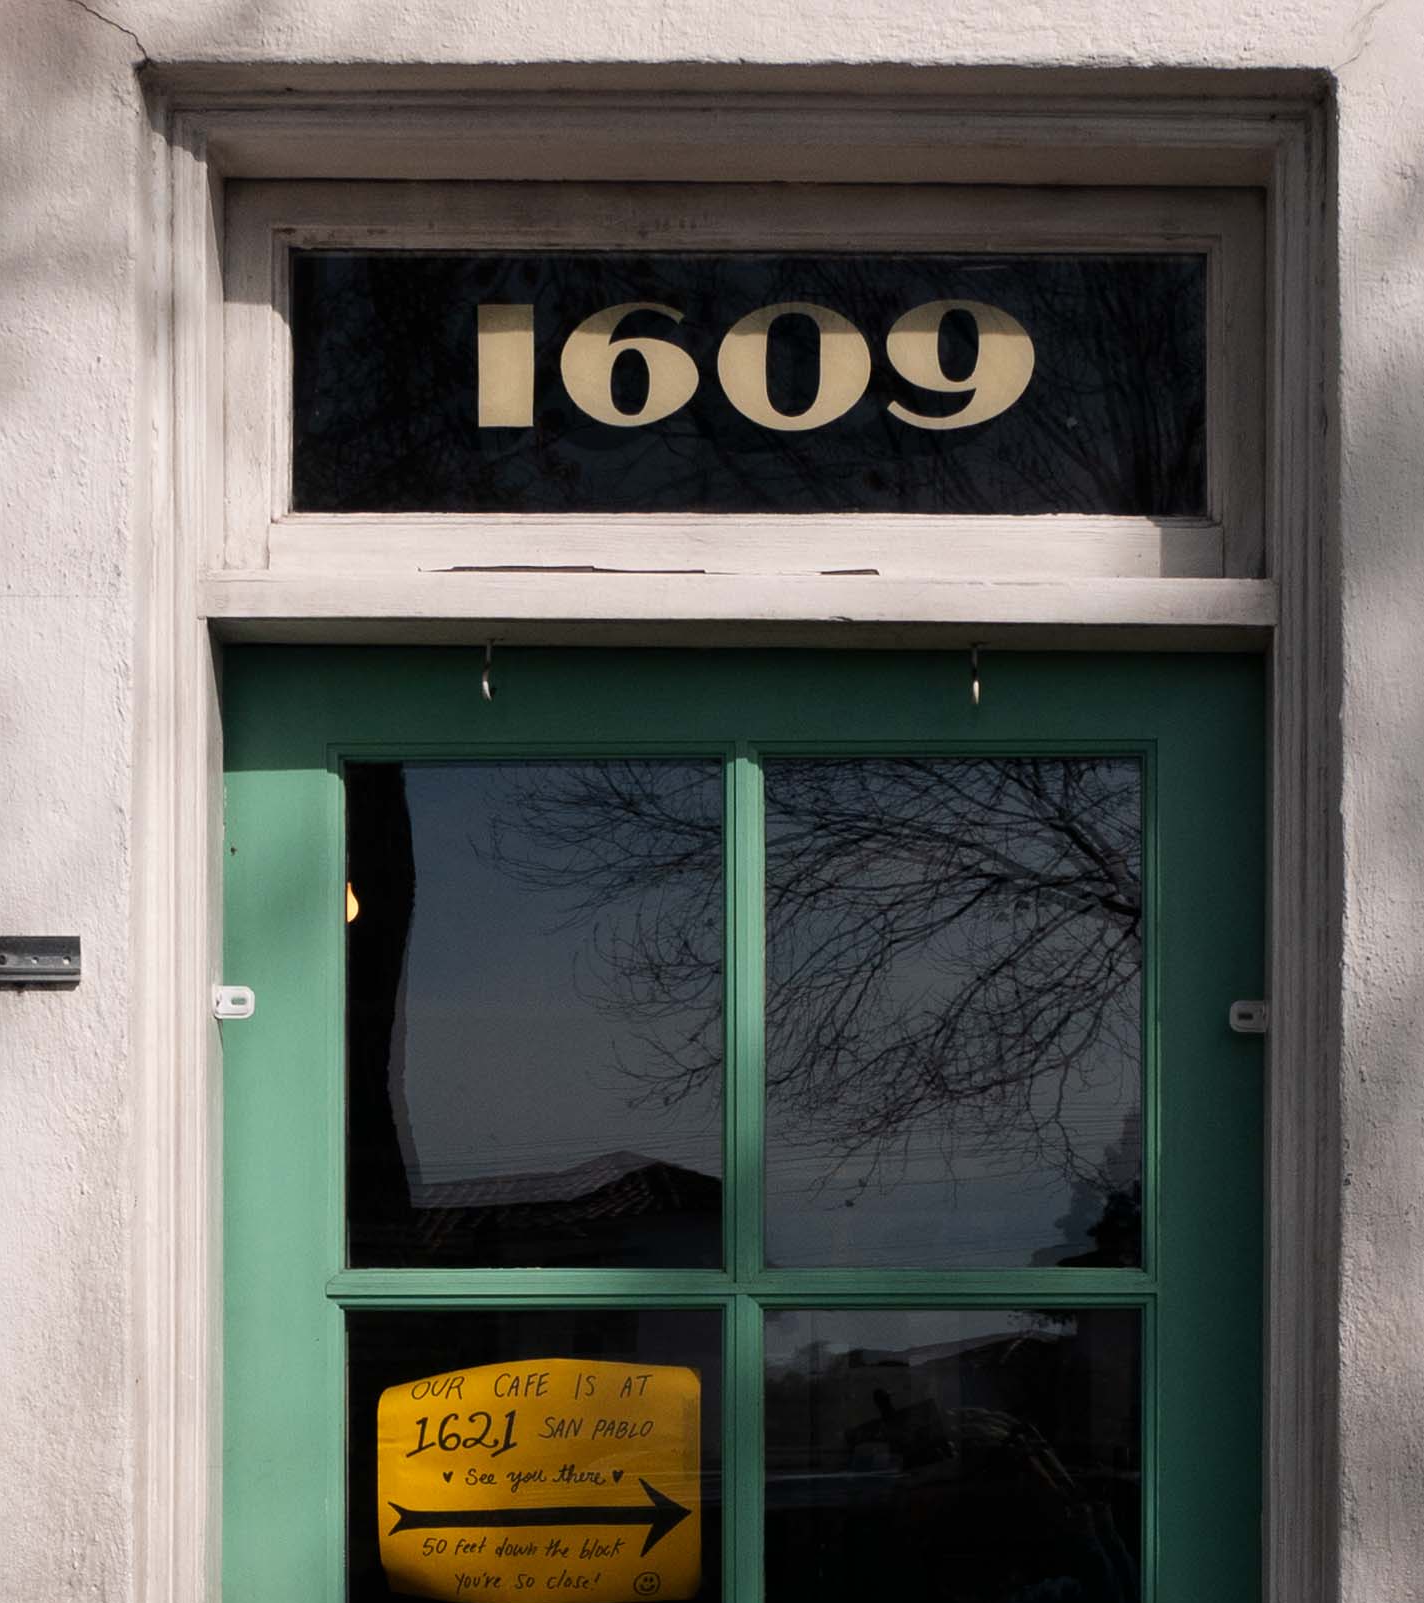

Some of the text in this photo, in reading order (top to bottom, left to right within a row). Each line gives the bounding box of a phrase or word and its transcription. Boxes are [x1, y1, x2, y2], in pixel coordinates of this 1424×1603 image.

[477, 299, 1036, 431] 1609
[411, 1372, 652, 1401] OUR CAFE IS AT
[406, 1409, 655, 1458] 1621 SAN PABLO
[465, 1463, 606, 1493] See you there
[422, 1537, 448, 1557] 50
[495, 1536, 537, 1558] down
[544, 1537, 568, 1558] the
[579, 1536, 626, 1560] block
[546, 1569, 602, 1592] close!
